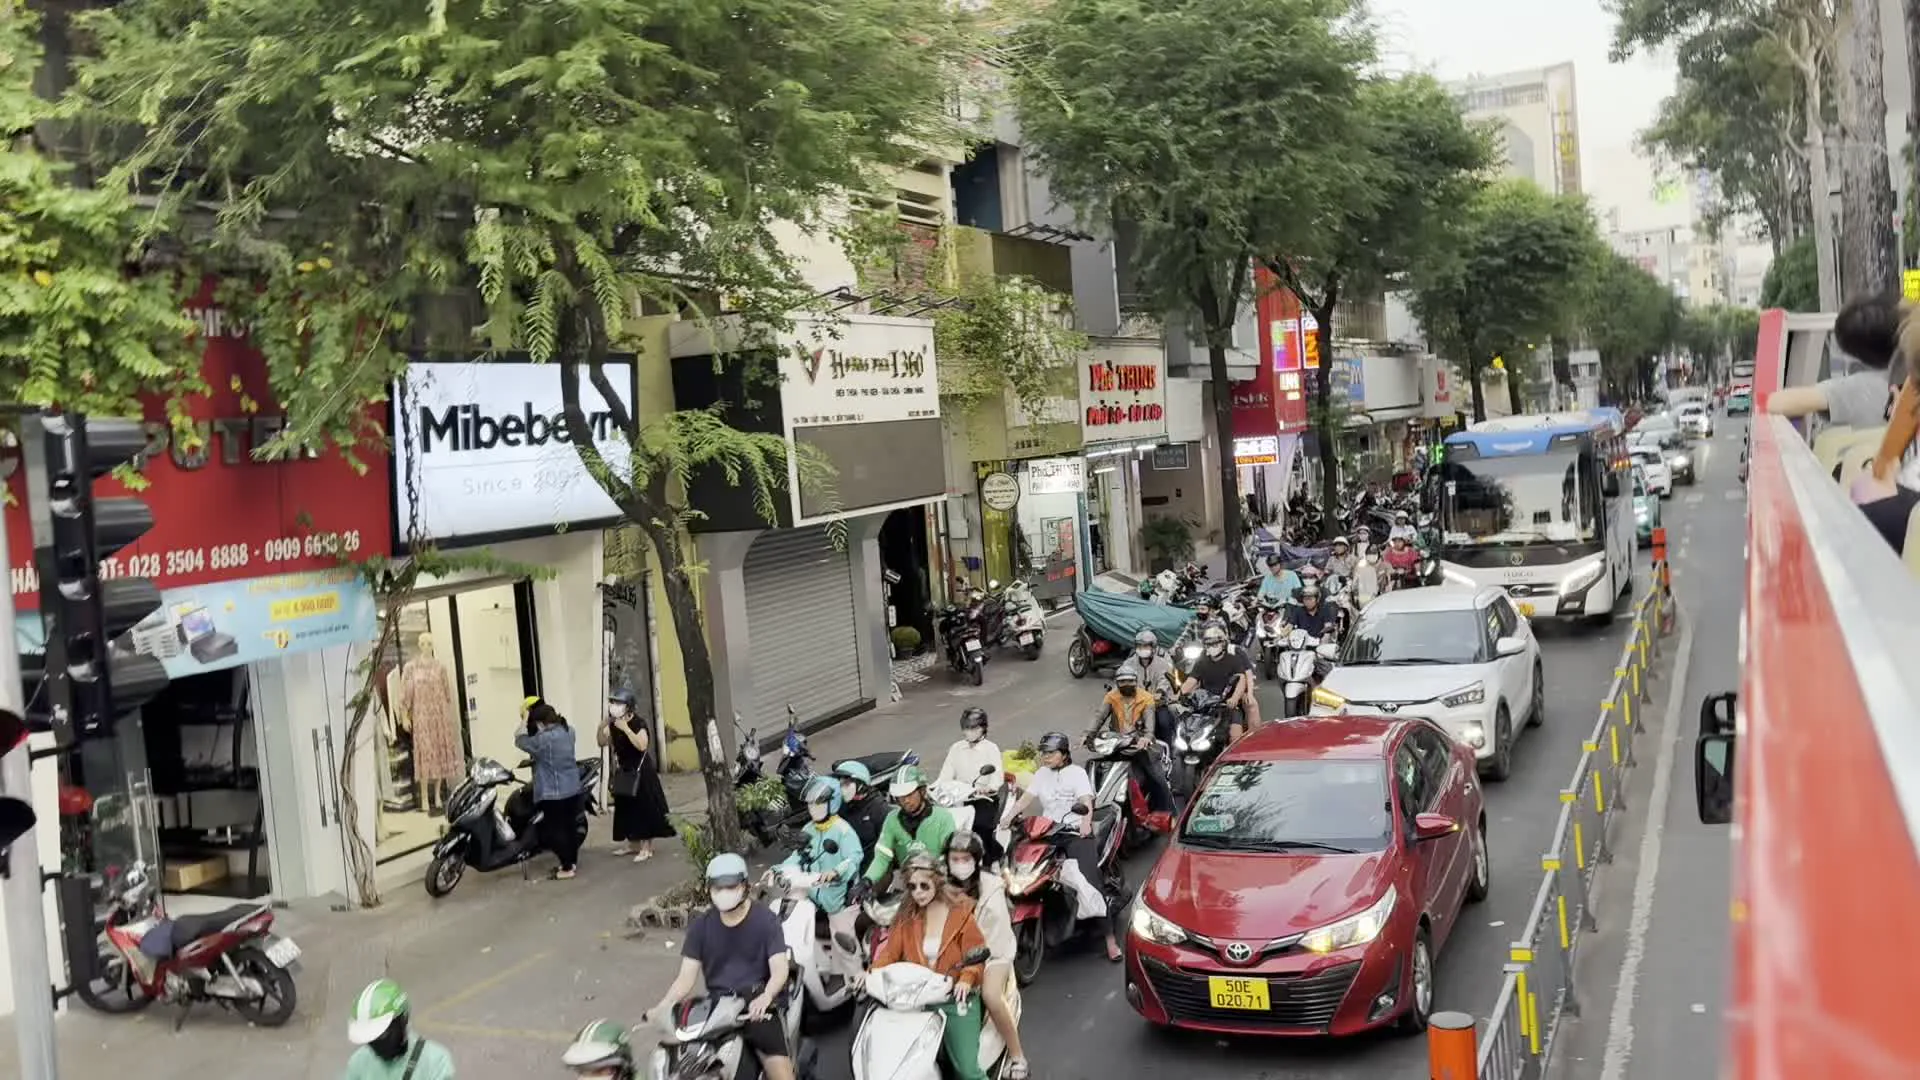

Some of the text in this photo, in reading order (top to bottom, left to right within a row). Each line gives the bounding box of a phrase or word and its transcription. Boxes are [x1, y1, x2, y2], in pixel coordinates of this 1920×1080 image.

[462, 478, 522, 496] Since
[129, 554, 161, 578] 028
[166, 547, 204, 575] 3504
[210, 543, 249, 569] 8888
[264, 537, 301, 561] 0909
[343, 529, 360, 551] 26
[1225, 980, 1251, 993] 50E
[1217, 993, 1262, 1008] 020.71
